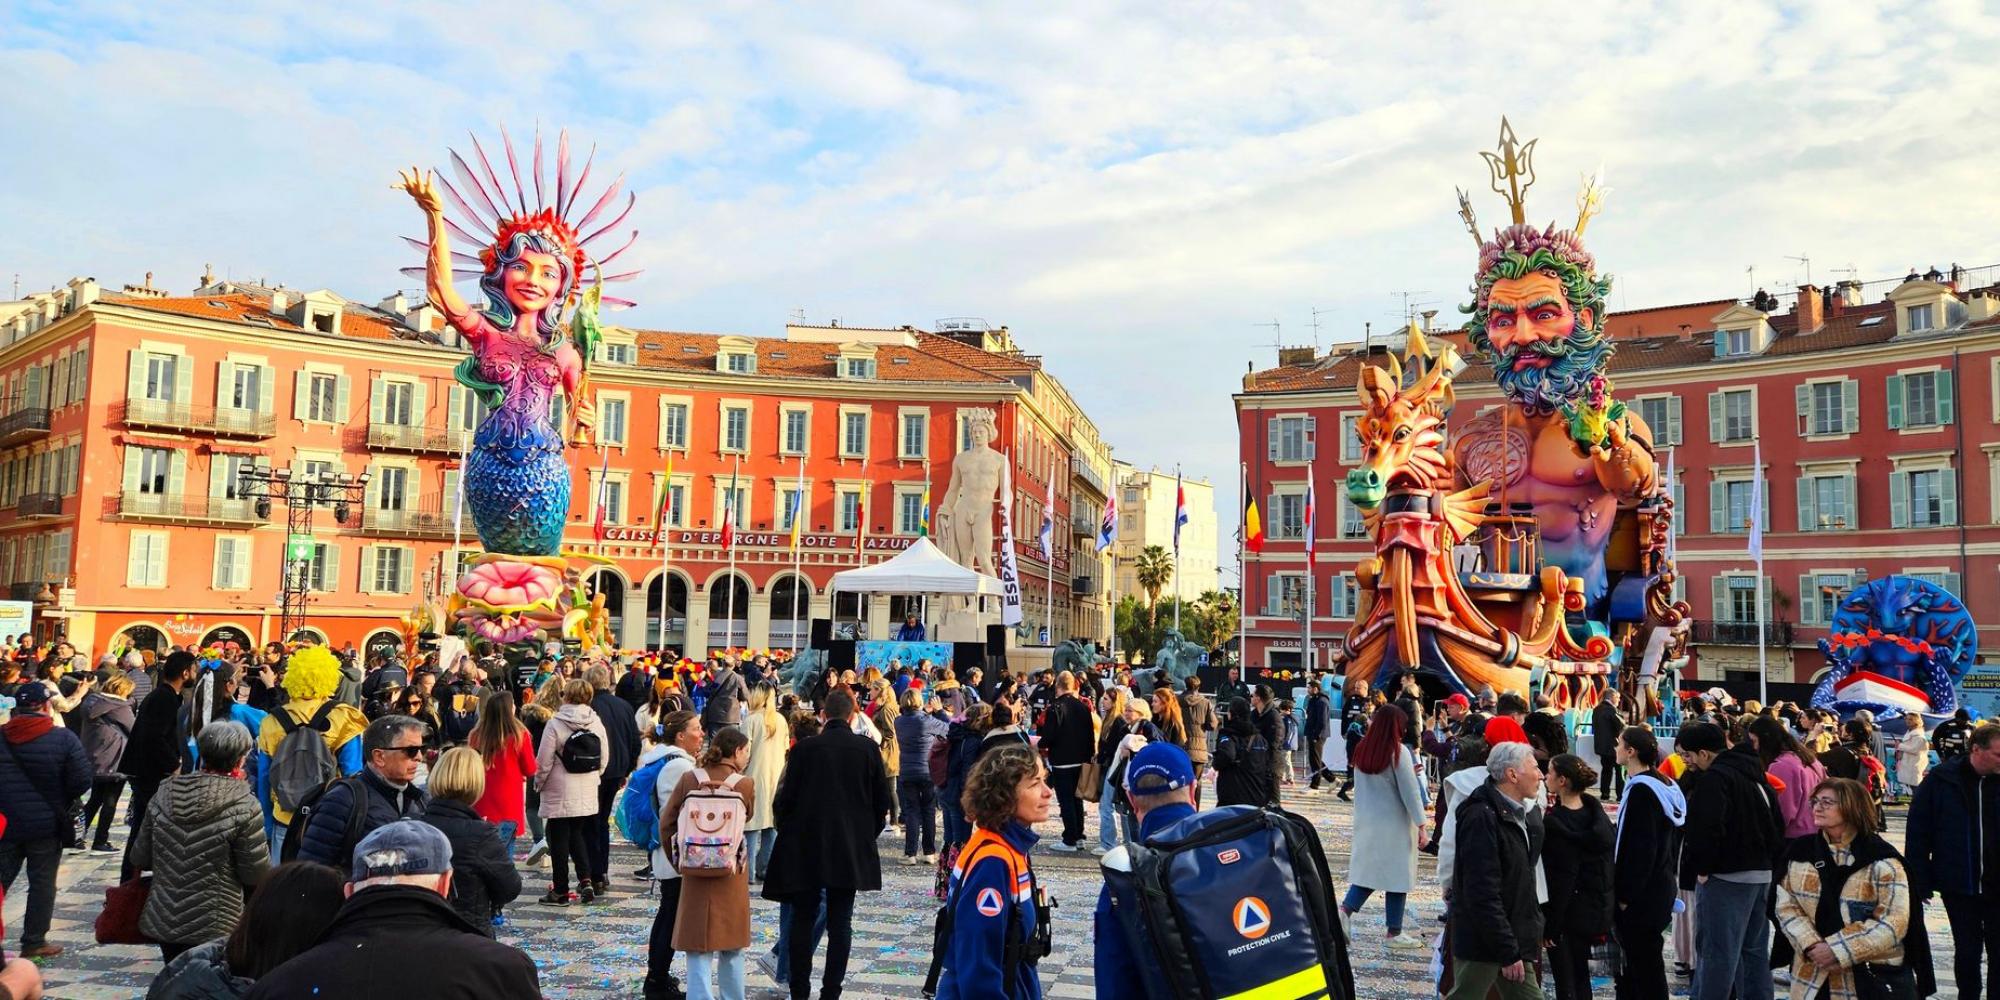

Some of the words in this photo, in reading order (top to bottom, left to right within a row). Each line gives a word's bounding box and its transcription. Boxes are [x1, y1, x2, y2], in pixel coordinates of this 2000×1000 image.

[606, 529, 666, 541] CAISSE
[682, 532, 778, 545] D'EPRGNE
[1228, 936, 1270, 957] PROTECTION
[1270, 929, 1291, 943] CIVILE
